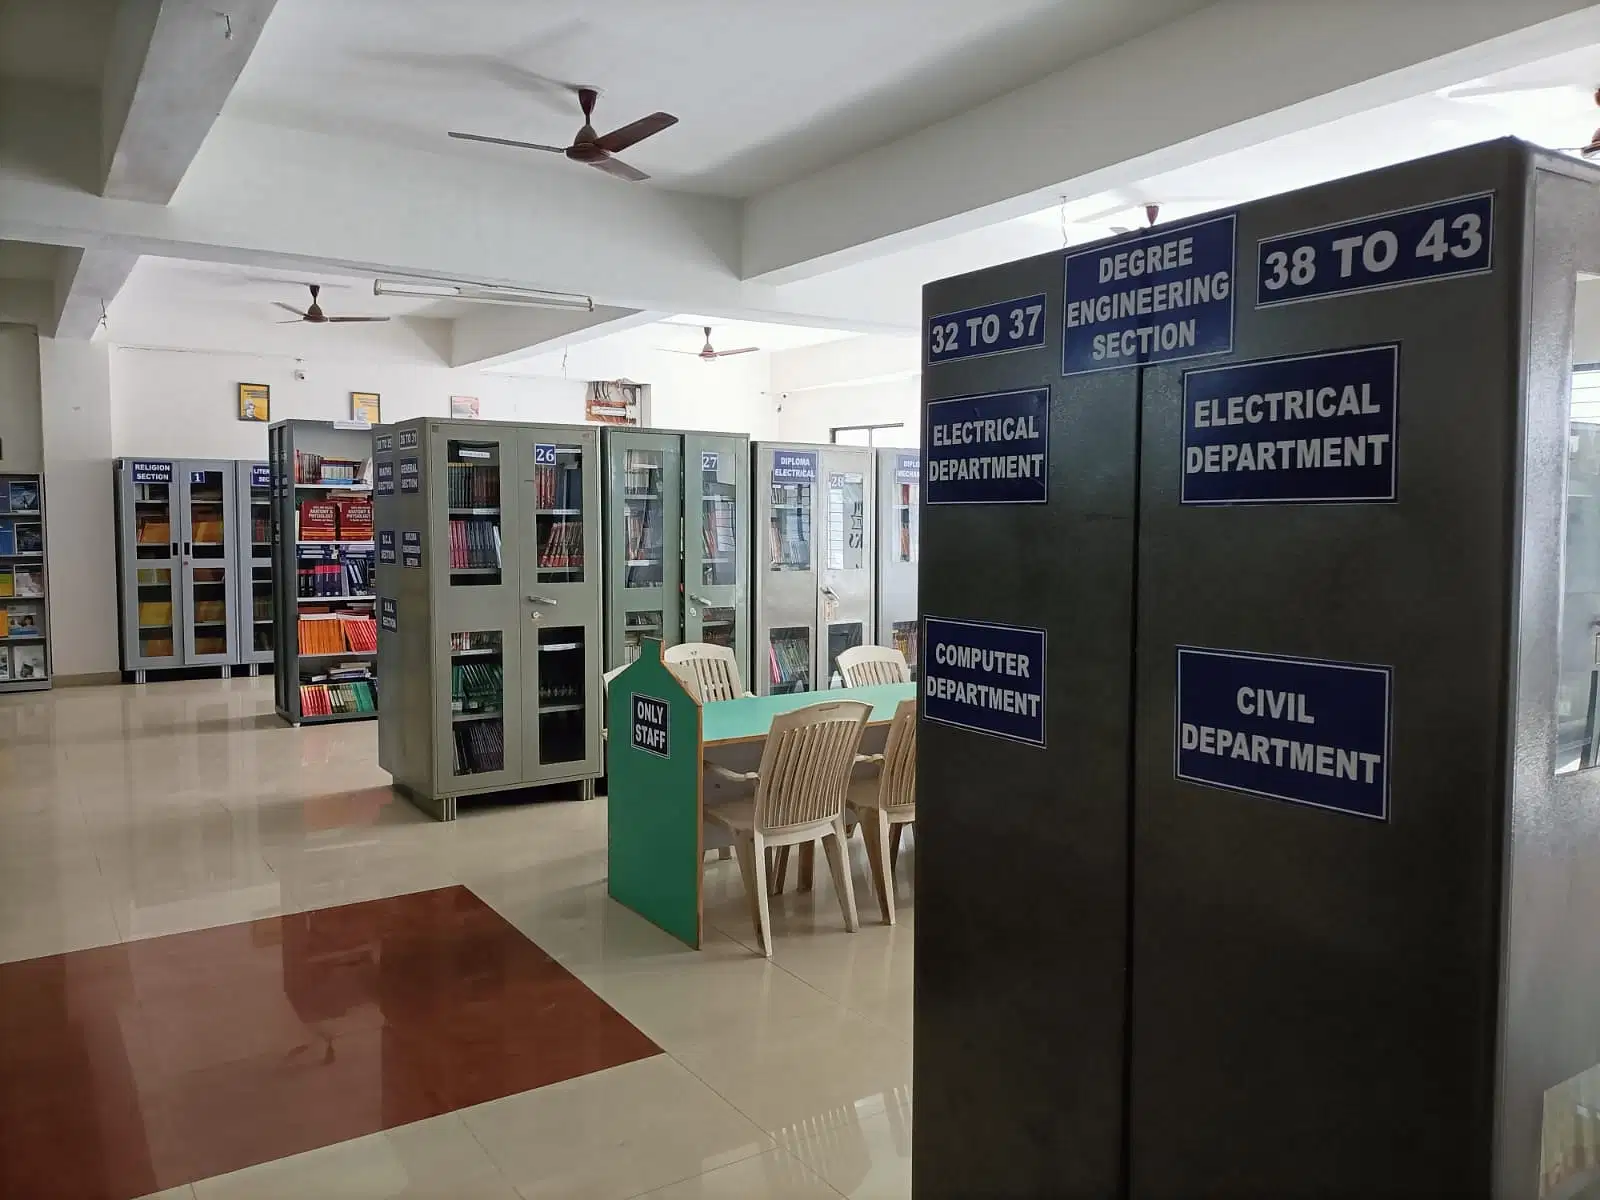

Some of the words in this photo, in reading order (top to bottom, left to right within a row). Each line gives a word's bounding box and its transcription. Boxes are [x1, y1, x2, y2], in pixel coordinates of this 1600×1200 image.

[1099, 237, 1194, 284] DEGREE
[1264, 246, 1317, 290] 38
[1332, 230, 1399, 278] TO
[1415, 213, 1483, 263] 43
[1066, 271, 1231, 329] ENGINEERING
[932, 321, 959, 354] 32
[966, 313, 1000, 347] TO
[1009, 304, 1043, 340] 37
[1092, 319, 1196, 361] SECTION
[1194, 383, 1381, 428] ELECTRICAL
[933, 415, 1040, 447] ELECTRICAL
[134, 463, 171, 472] RELIGION
[536, 448, 555, 462] 26
[703, 456, 717, 468] 27
[780, 457, 810, 467] DIPLOMA
[928, 453, 1044, 482] DEPARTMENT
[1186, 434, 1390, 474] DEPARTMENT
[136, 473, 169, 481] SECTION
[195, 473, 201, 482] 1
[401, 478, 418, 489] SECTION
[775, 468, 815, 478] ELECTRICAL
[935, 642, 1030, 679] COMPUTER
[926, 675, 1041, 718] DEPARTMENT
[1236, 686, 1315, 725] CIVIL
[637, 701, 664, 725] ONLY
[635, 723, 666, 749] STAFF
[1181, 722, 1381, 784] DEPARTMENT
